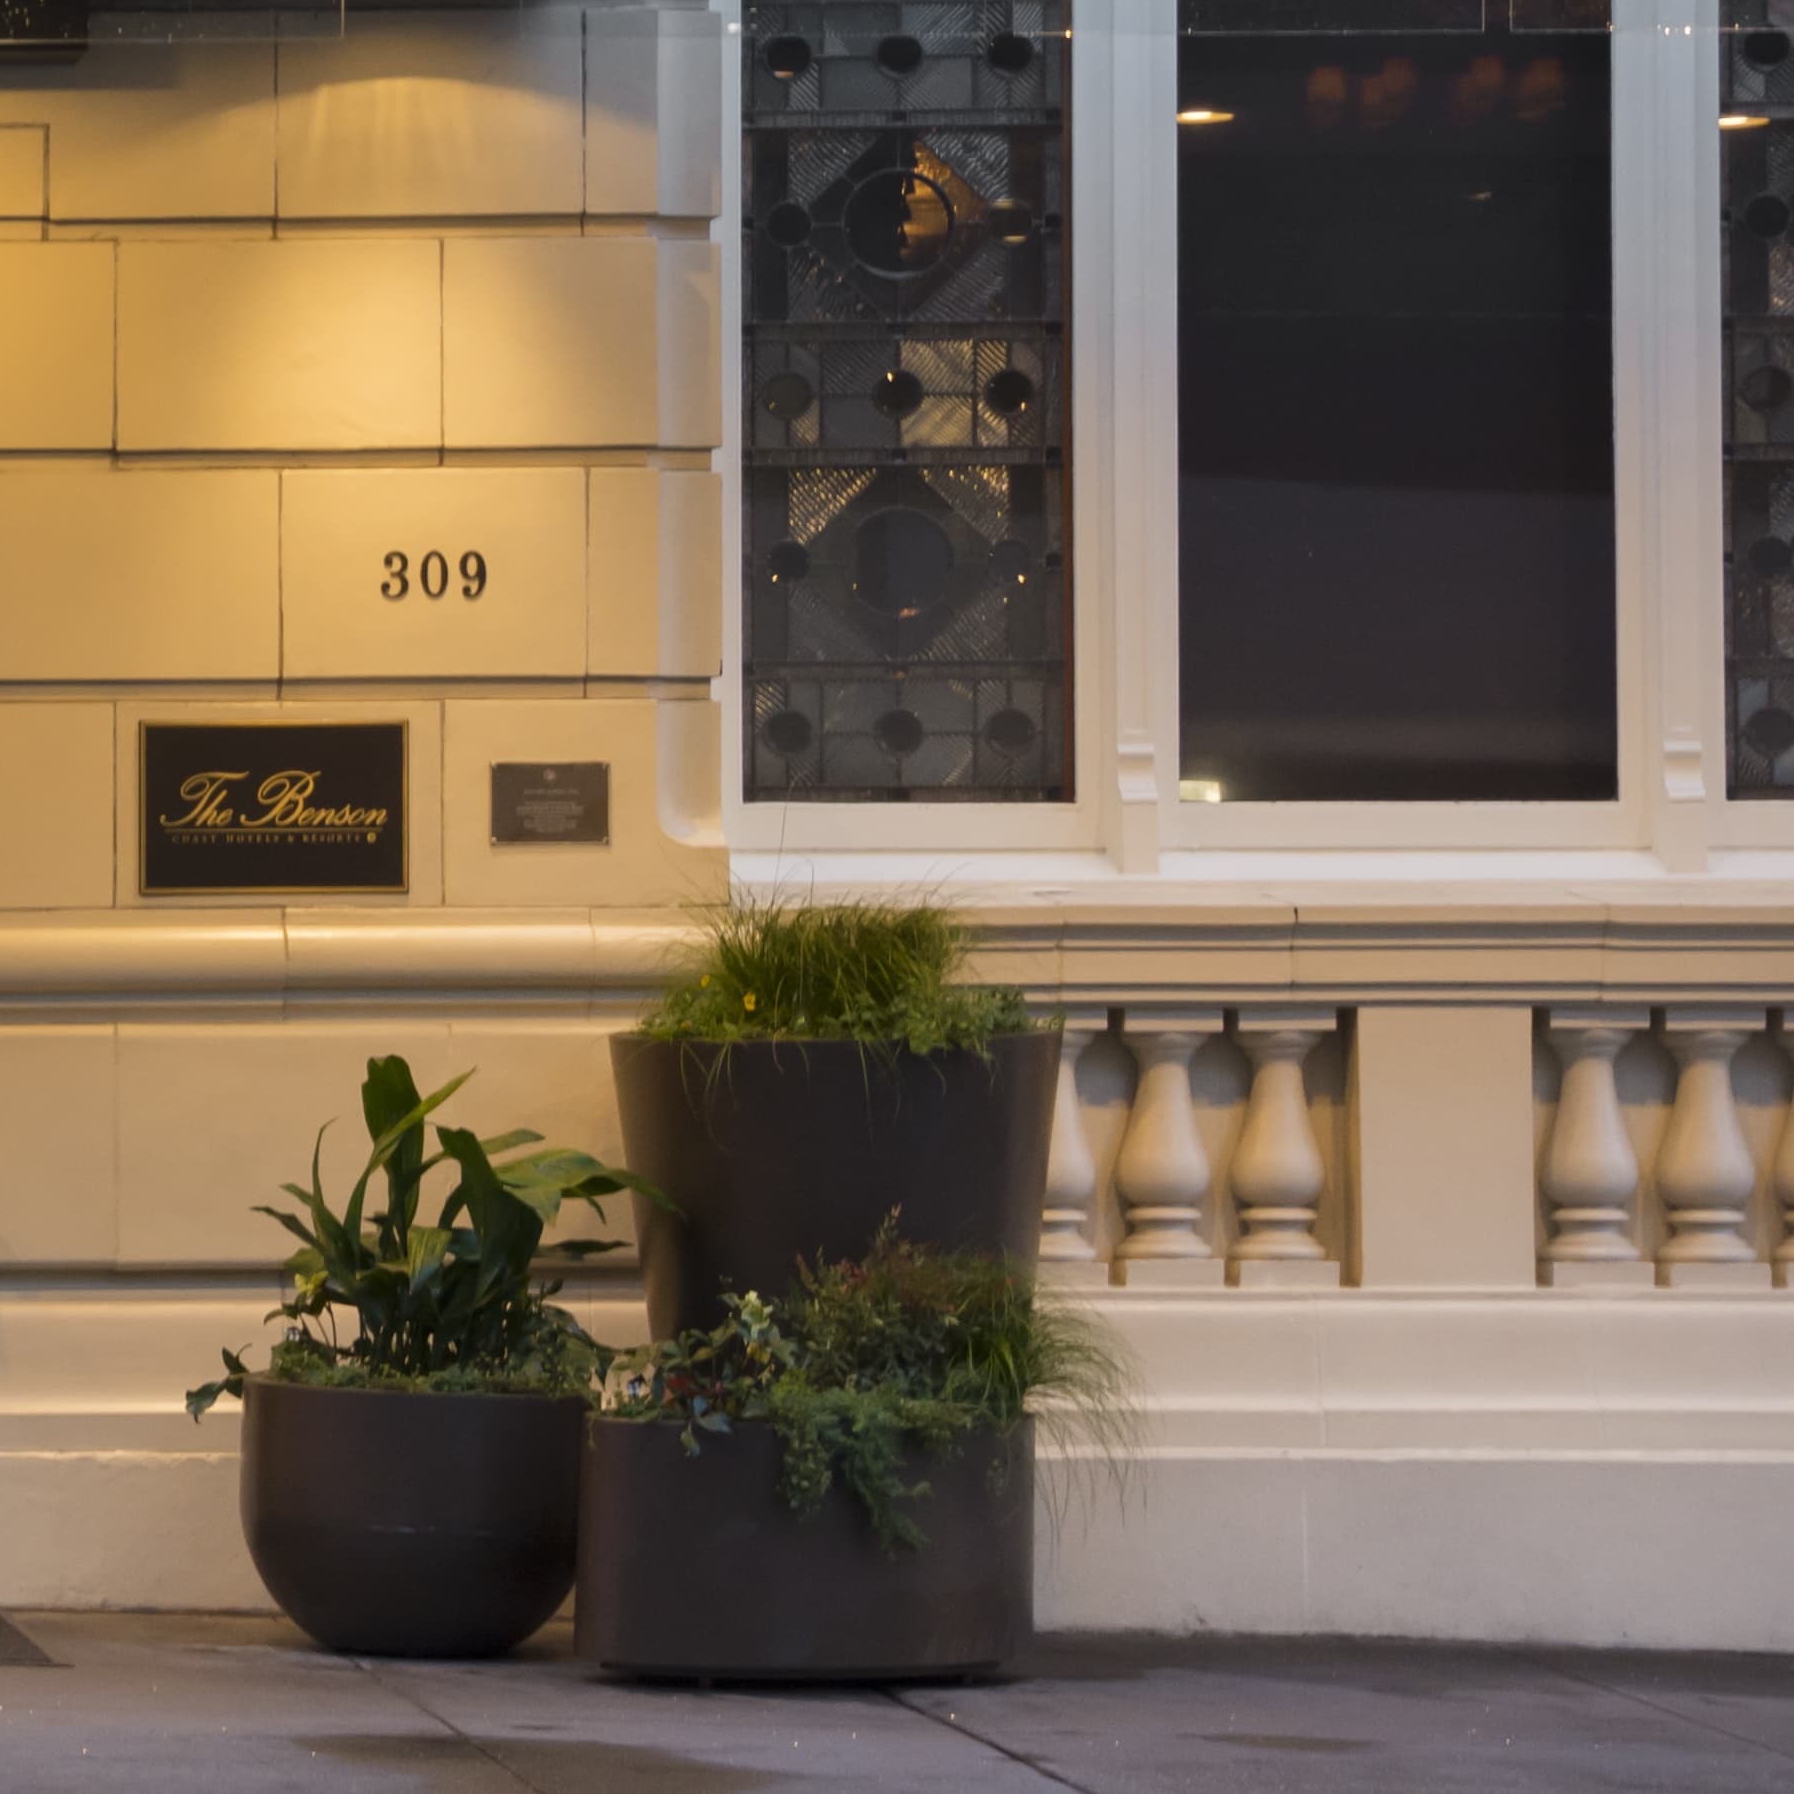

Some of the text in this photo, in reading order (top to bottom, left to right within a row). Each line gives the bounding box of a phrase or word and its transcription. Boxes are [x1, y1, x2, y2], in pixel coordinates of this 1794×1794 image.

[380, 550, 487, 601] 309
[159, 770, 388, 827] The Benson
